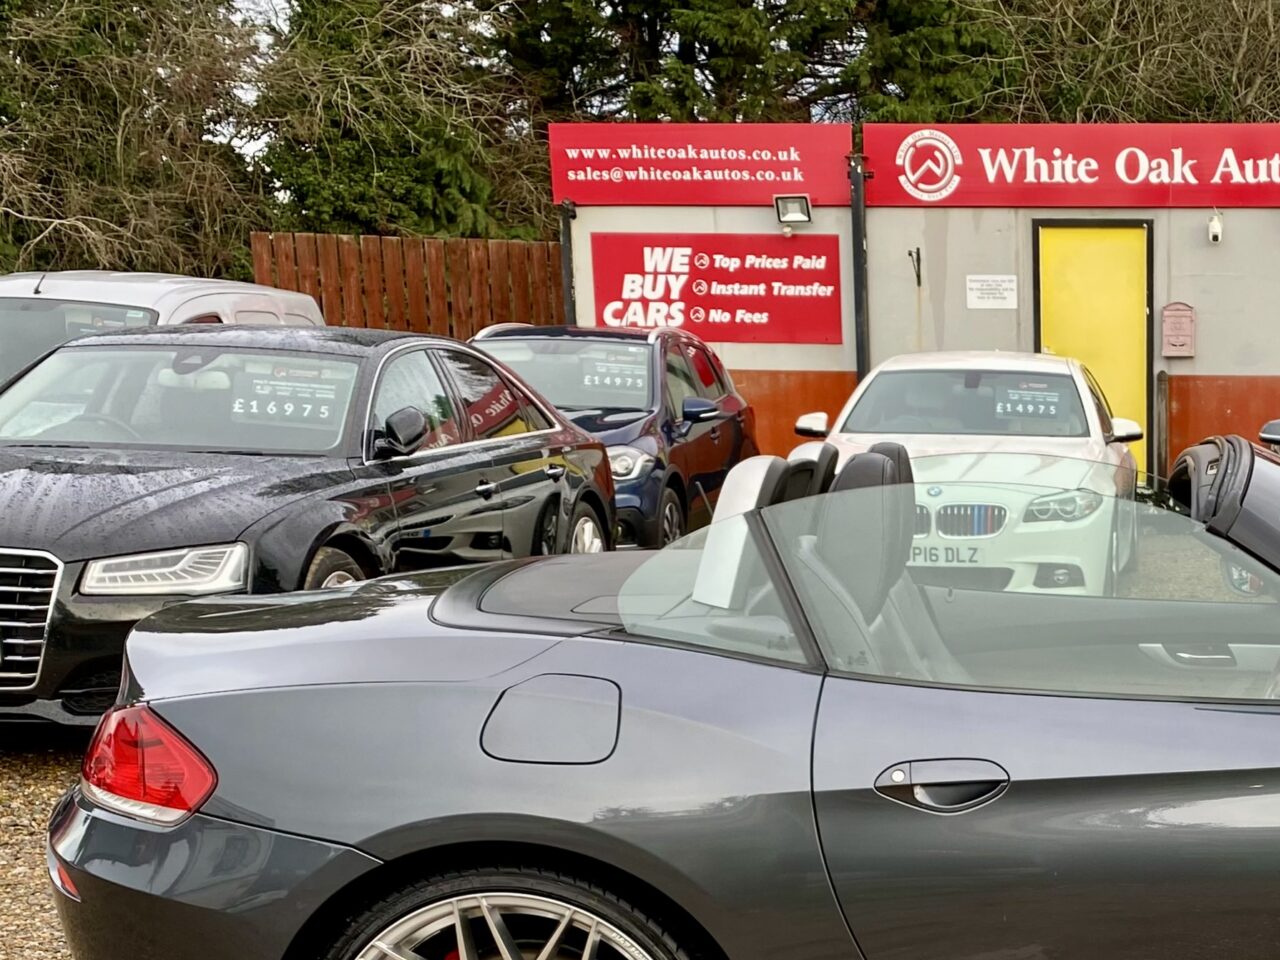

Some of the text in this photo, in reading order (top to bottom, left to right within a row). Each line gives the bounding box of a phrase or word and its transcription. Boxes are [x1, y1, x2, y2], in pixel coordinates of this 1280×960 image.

[565, 145, 801, 162] www.whiteoakautos.co.uk
[978, 146, 1099, 184] White
[1115, 147, 1199, 185] Oak
[567, 166, 804, 183] sales@whiteoakautos.co.uk
[643, 246, 692, 273] WE
[712, 254, 827, 272] Top Prices Paid
[622, 274, 689, 300] BUY
[711, 281, 834, 297] Instant Transfer
[603, 302, 685, 327] CARS
[708, 309, 769, 324] No Fees
[233, 398, 329, 418] £16975
[996, 402, 1056, 415] £14975
[912, 546, 979, 563] P16 DLZ
